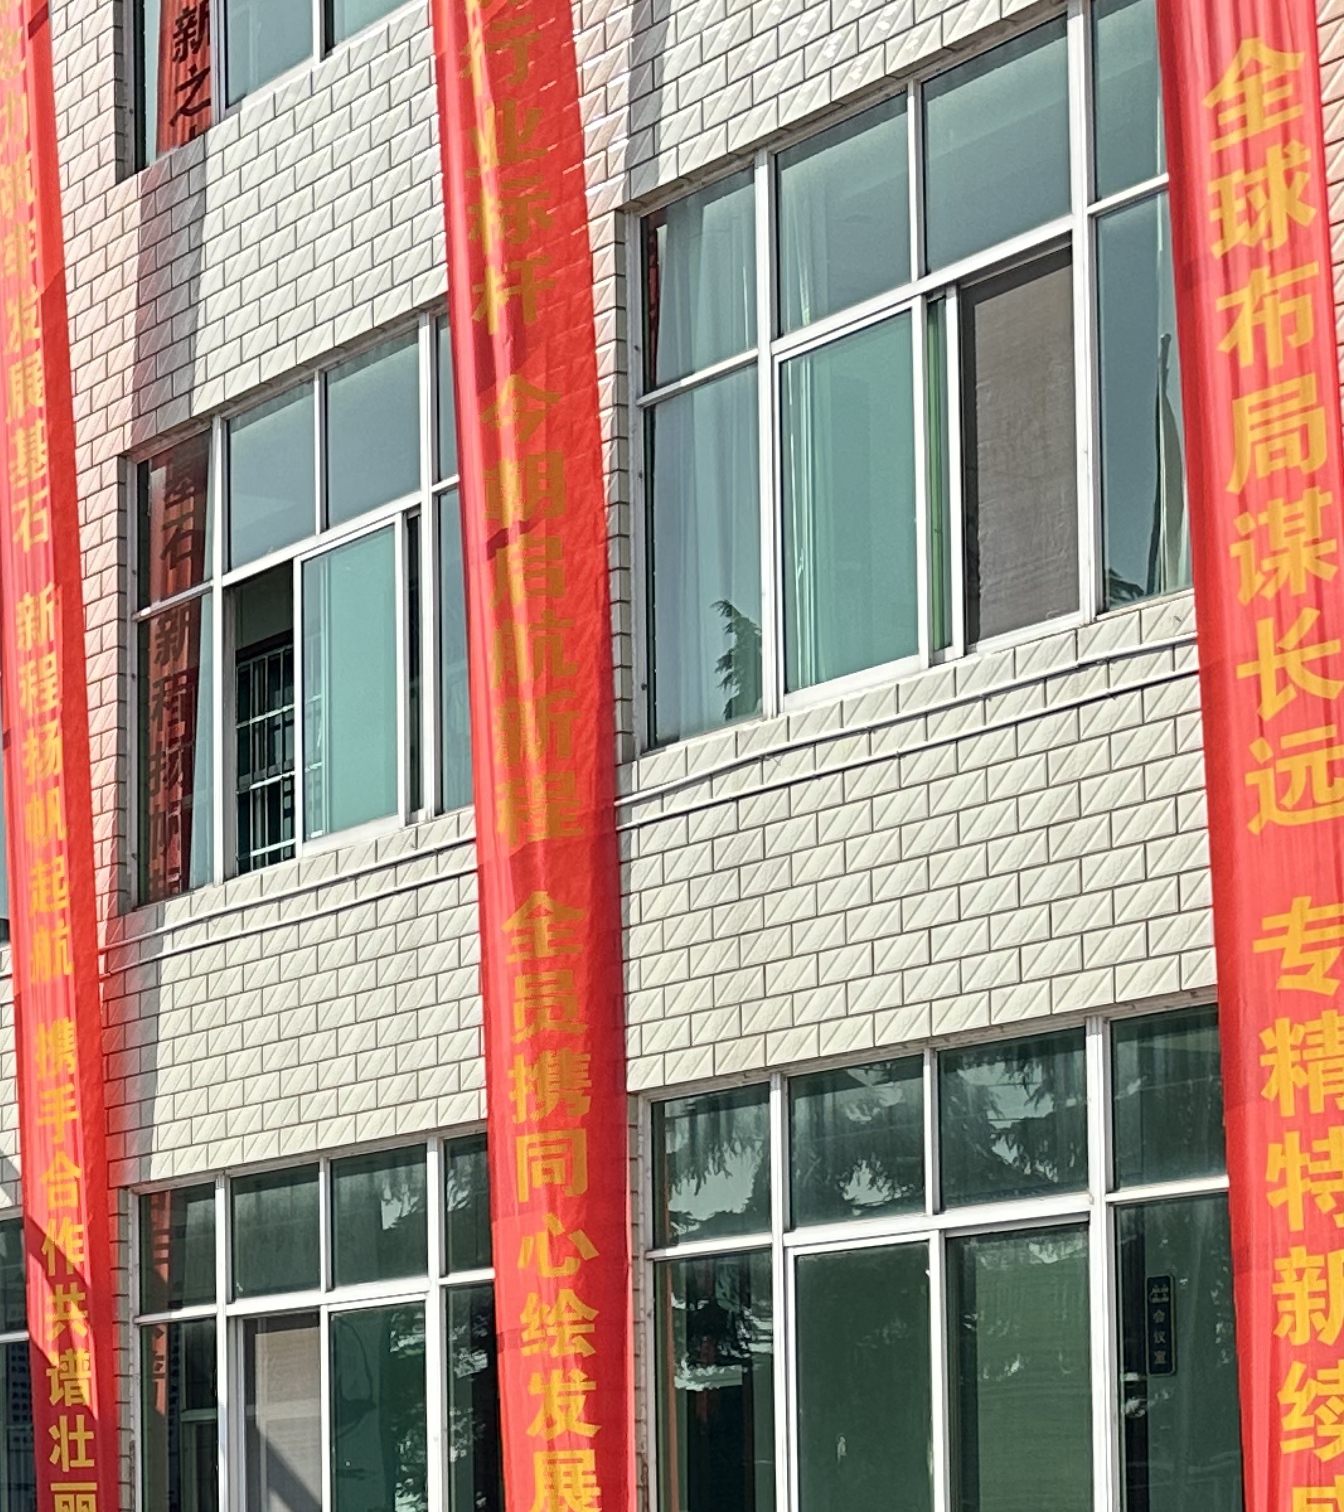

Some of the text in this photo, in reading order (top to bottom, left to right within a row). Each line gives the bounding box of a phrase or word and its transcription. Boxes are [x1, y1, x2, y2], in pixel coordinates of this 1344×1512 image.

[1202, 36, 1344, 835] 全球布局谋长远
[15, 581, 74, 984] 新程扬帆起航
